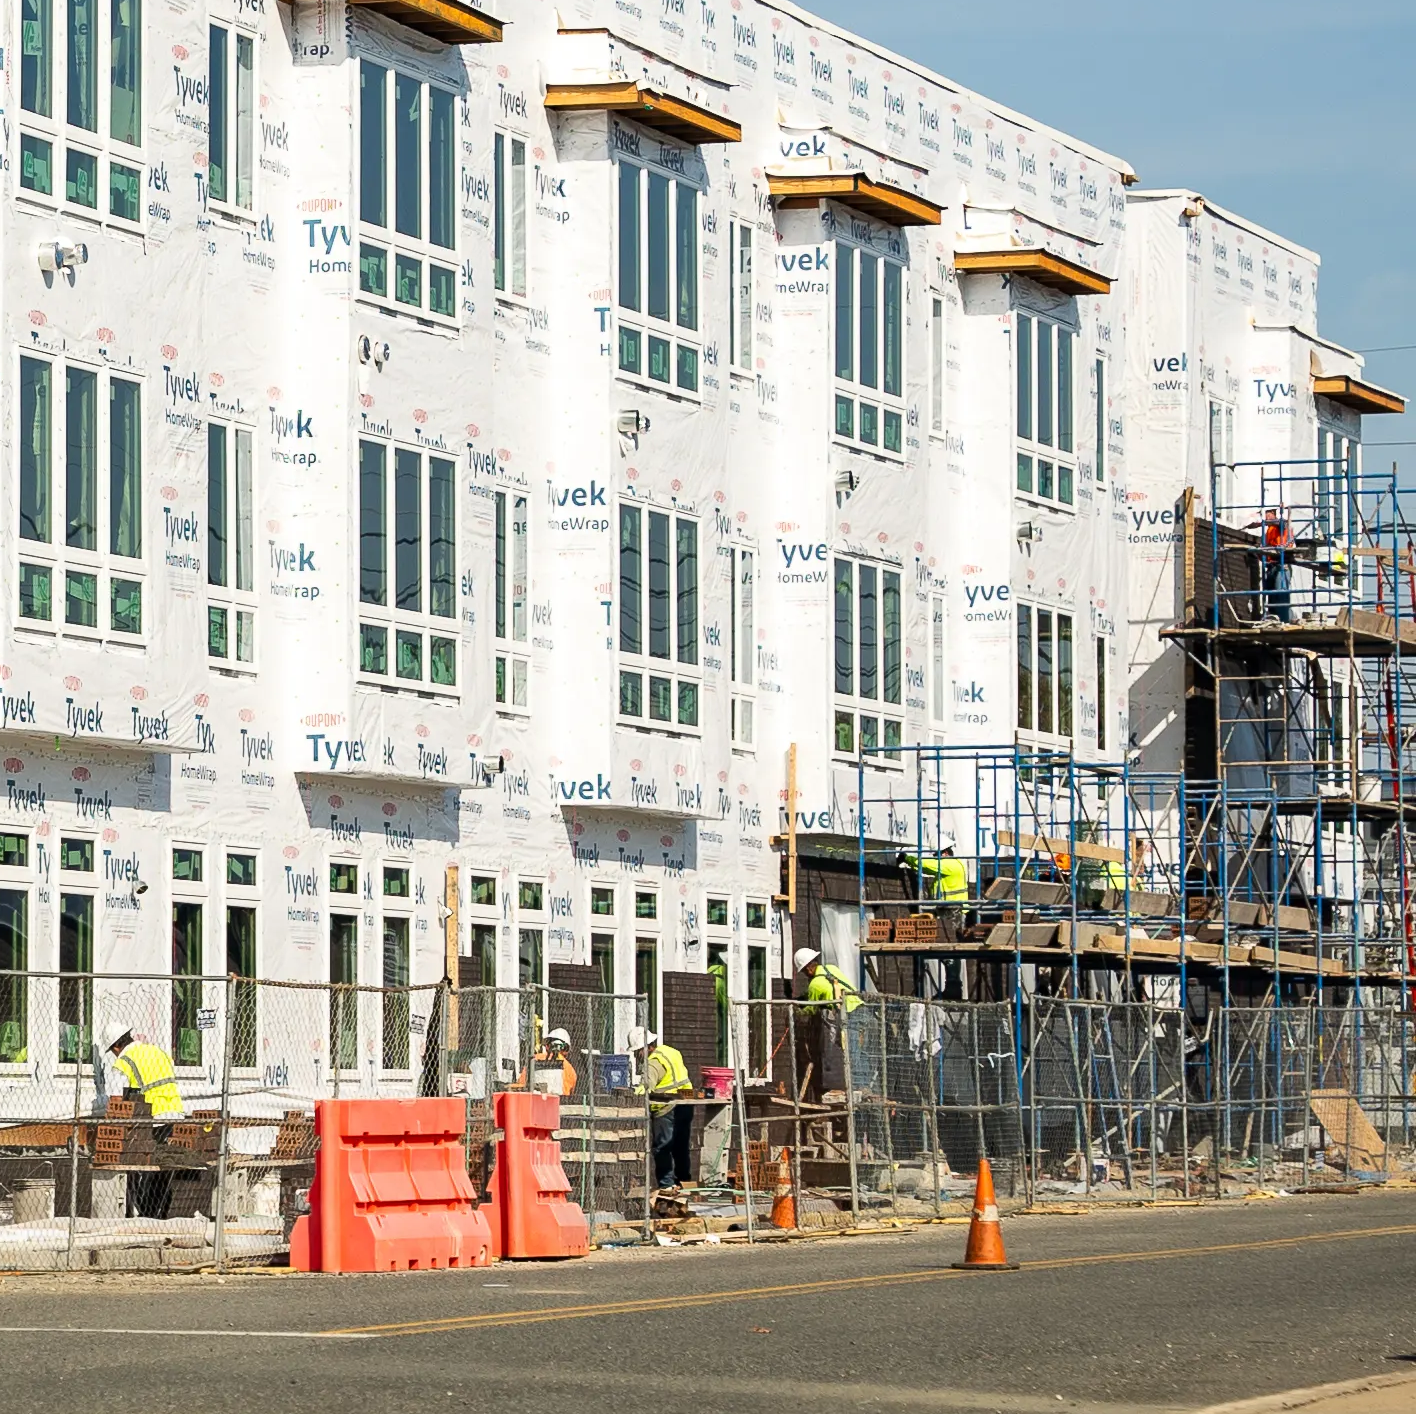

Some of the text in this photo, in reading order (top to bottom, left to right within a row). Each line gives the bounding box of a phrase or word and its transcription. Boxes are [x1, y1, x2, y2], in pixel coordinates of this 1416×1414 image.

[733, 15, 757, 48] Tyvek
[773, 34, 795, 66] Tyvek
[810, 51, 833, 83] Tyvek
[174, 66, 209, 107] Tyvek
[848, 69, 868, 100] Tyvek
[498, 83, 528, 118] Tyvek
[884, 86, 905, 116] Tyvek
[919, 102, 940, 132] Tyvek
[952, 118, 972, 147] Tyvek
[985, 133, 1005, 162] Tyvek
[1017, 147, 1036, 176] Tyvek
[1050, 162, 1068, 189] Tyvek
[1080, 176, 1097, 202] Tyvek
[302, 199, 337, 212] DUPONT
[163, 366, 200, 407] Tyvek
[165, 408, 202, 433] HomeWrap
[467, 443, 497, 477] Tyvek
[163, 507, 198, 547] Tyvek
[165, 550, 200, 574] HomeWrap
[269, 539, 316, 577] Tyvek
[67, 698, 104, 737] Tyvek
[305, 715, 340, 727] DUPONT
[241, 729, 274, 766] Tyvek
[418, 744, 447, 778] Tyvek
[181, 763, 217, 783] HomeWrap
[241, 770, 275, 789] HomeWrap
[504, 769, 529, 801] Tyvek
[104, 850, 140, 890] Tyvek
[285, 866, 318, 901] Tyvek
[287, 906, 319, 925] HomeWrap
